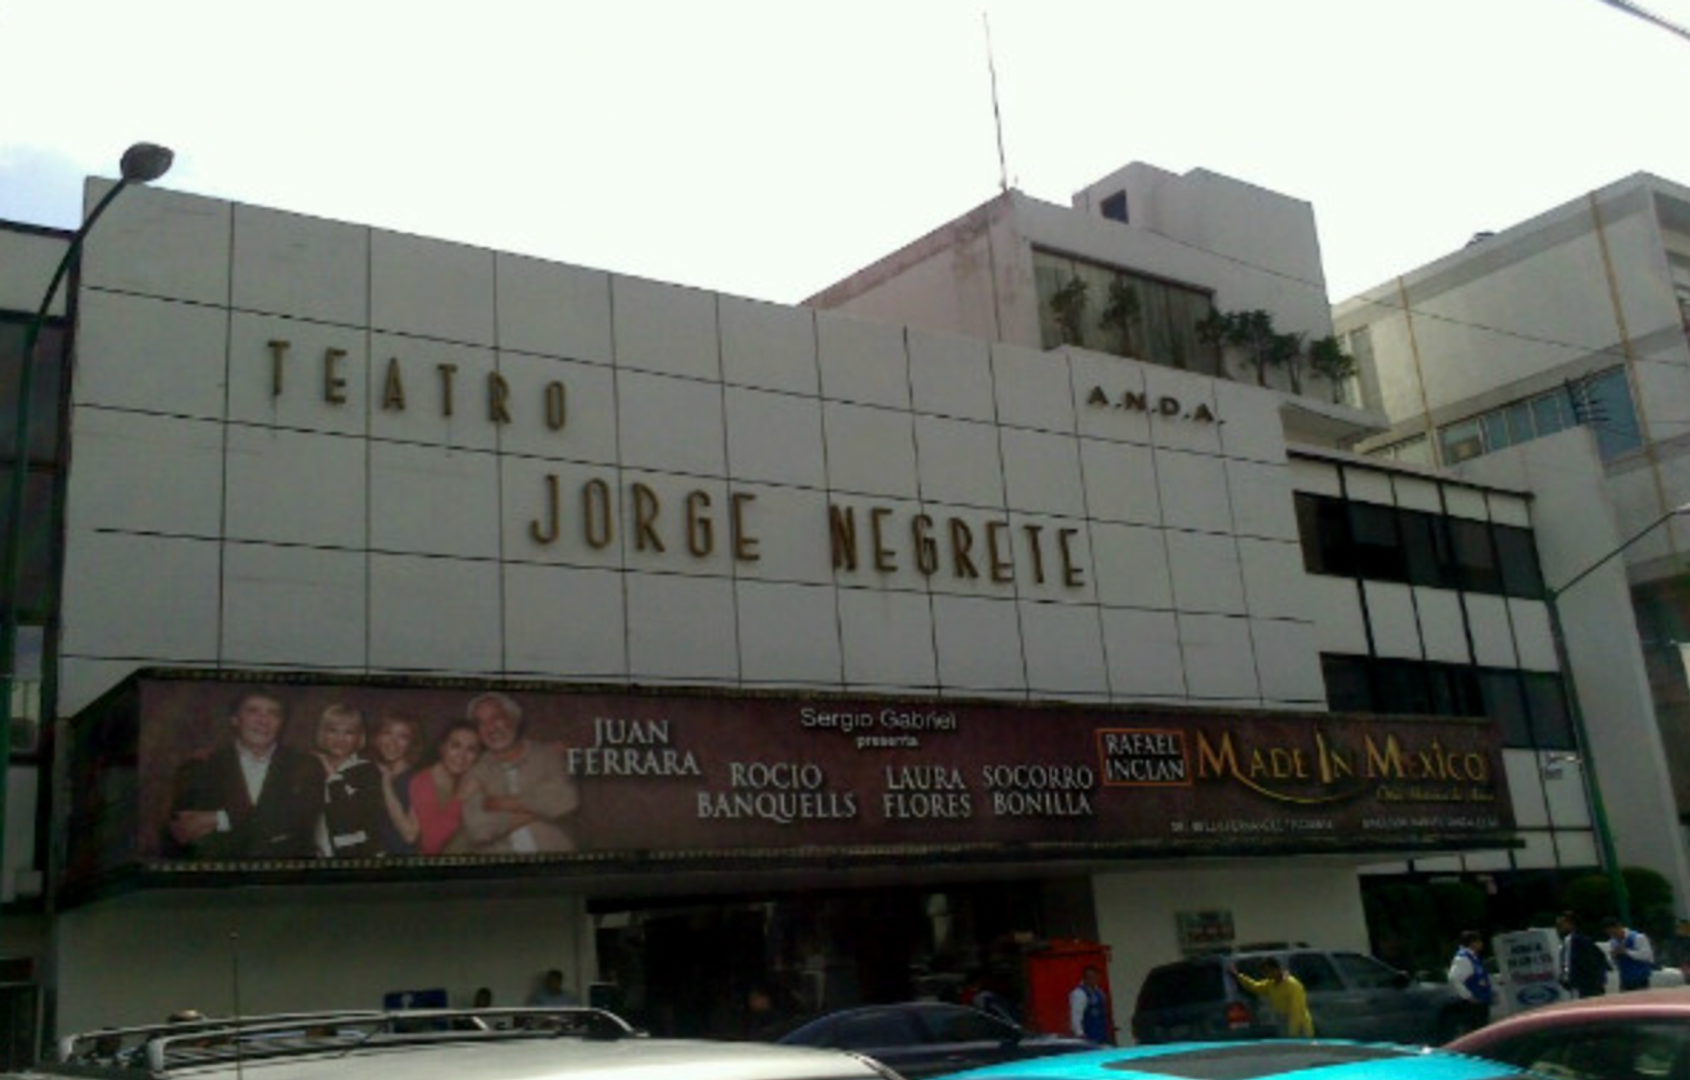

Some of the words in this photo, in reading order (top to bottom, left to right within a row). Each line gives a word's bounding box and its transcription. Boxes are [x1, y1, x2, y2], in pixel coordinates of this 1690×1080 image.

[267, 340, 567, 432] TEATRO
[1086, 386, 1226, 425] A.N.D.A.
[529, 474, 761, 561] JORGE
[829, 504, 1086, 588] NEGRETE
[595, 717, 670, 747] JUAN
[800, 707, 874, 732] Sergio
[880, 708, 957, 731] Gabriel
[1105, 732, 1181, 756] RAFAEL
[566, 747, 702, 776] FERRARA
[1105, 758, 1186, 782] INCLAN
[730, 762, 823, 790] ROCIO
[885, 765, 966, 791] LAURA
[982, 764, 1094, 790] SOCORRO
[697, 791, 857, 824] BANQUELLS
[883, 793, 971, 819] FLORES
[993, 791, 1093, 816] BONILLA
